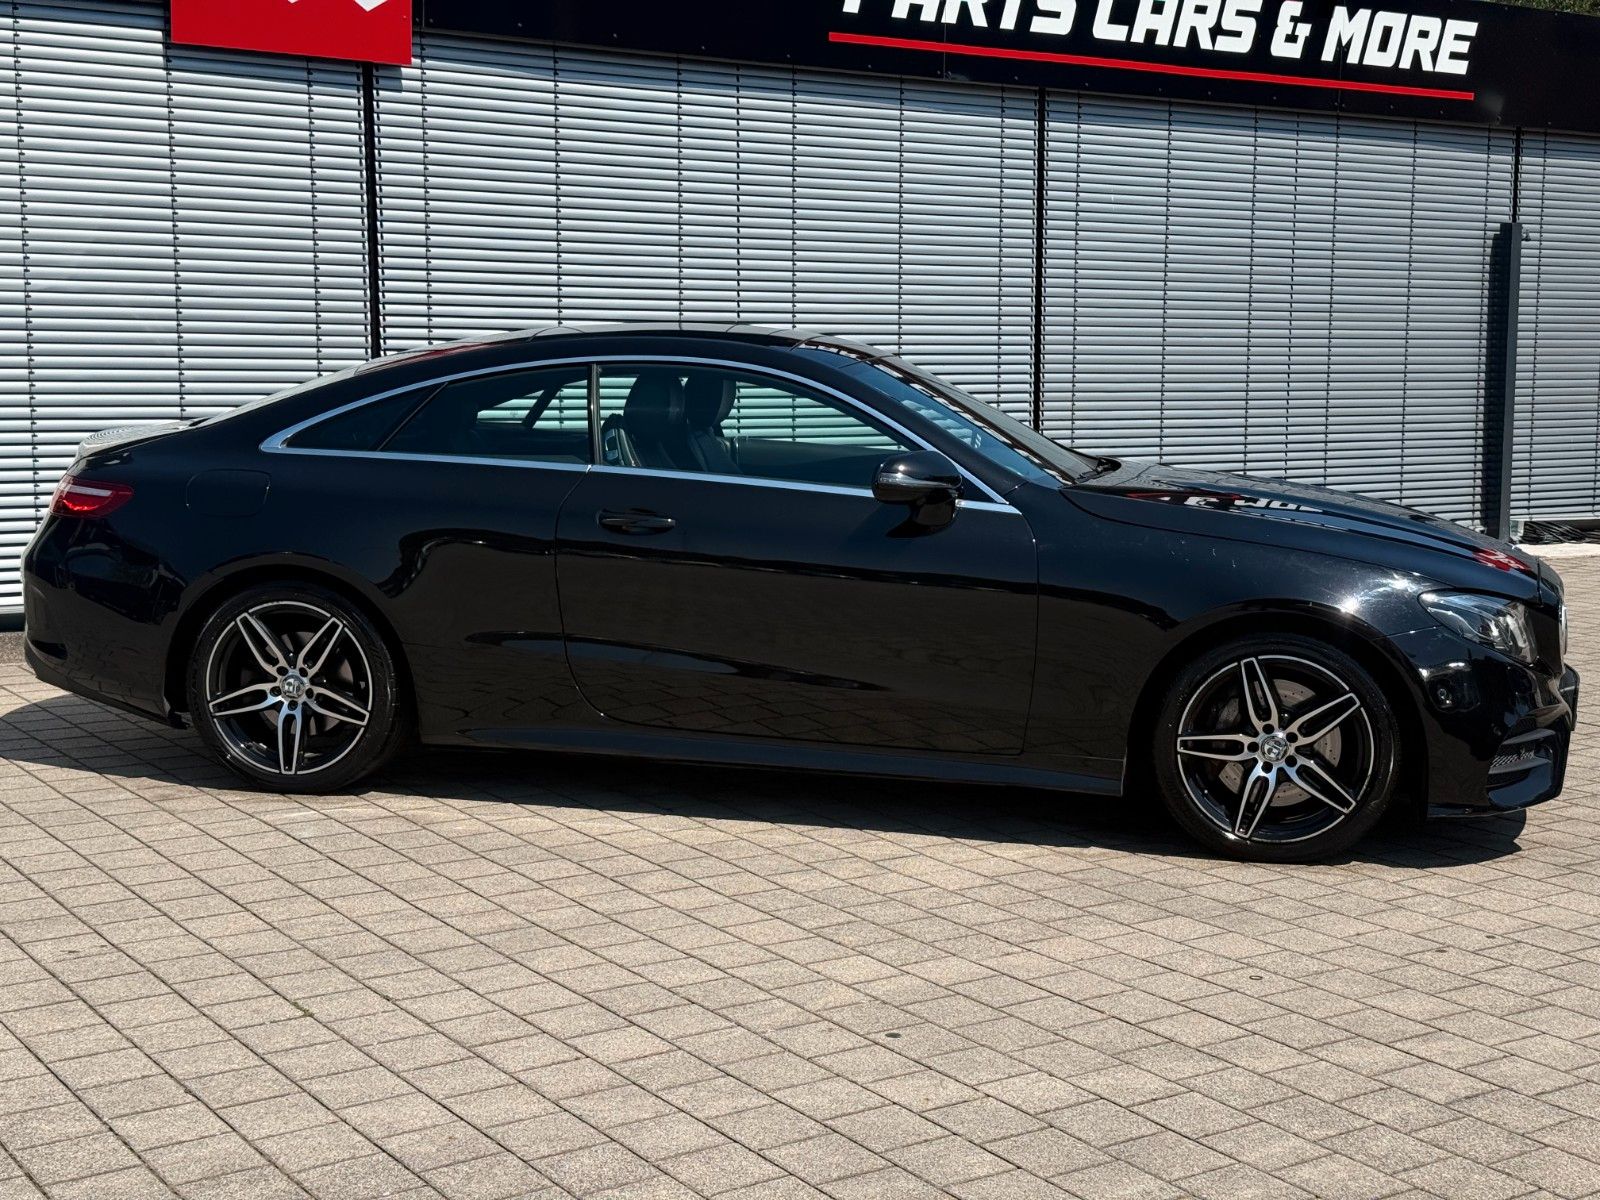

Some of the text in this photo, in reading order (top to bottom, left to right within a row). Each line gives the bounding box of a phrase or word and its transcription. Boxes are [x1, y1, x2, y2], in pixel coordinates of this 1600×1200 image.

[842, 0, 1479, 75] RTS CARS & MORE
